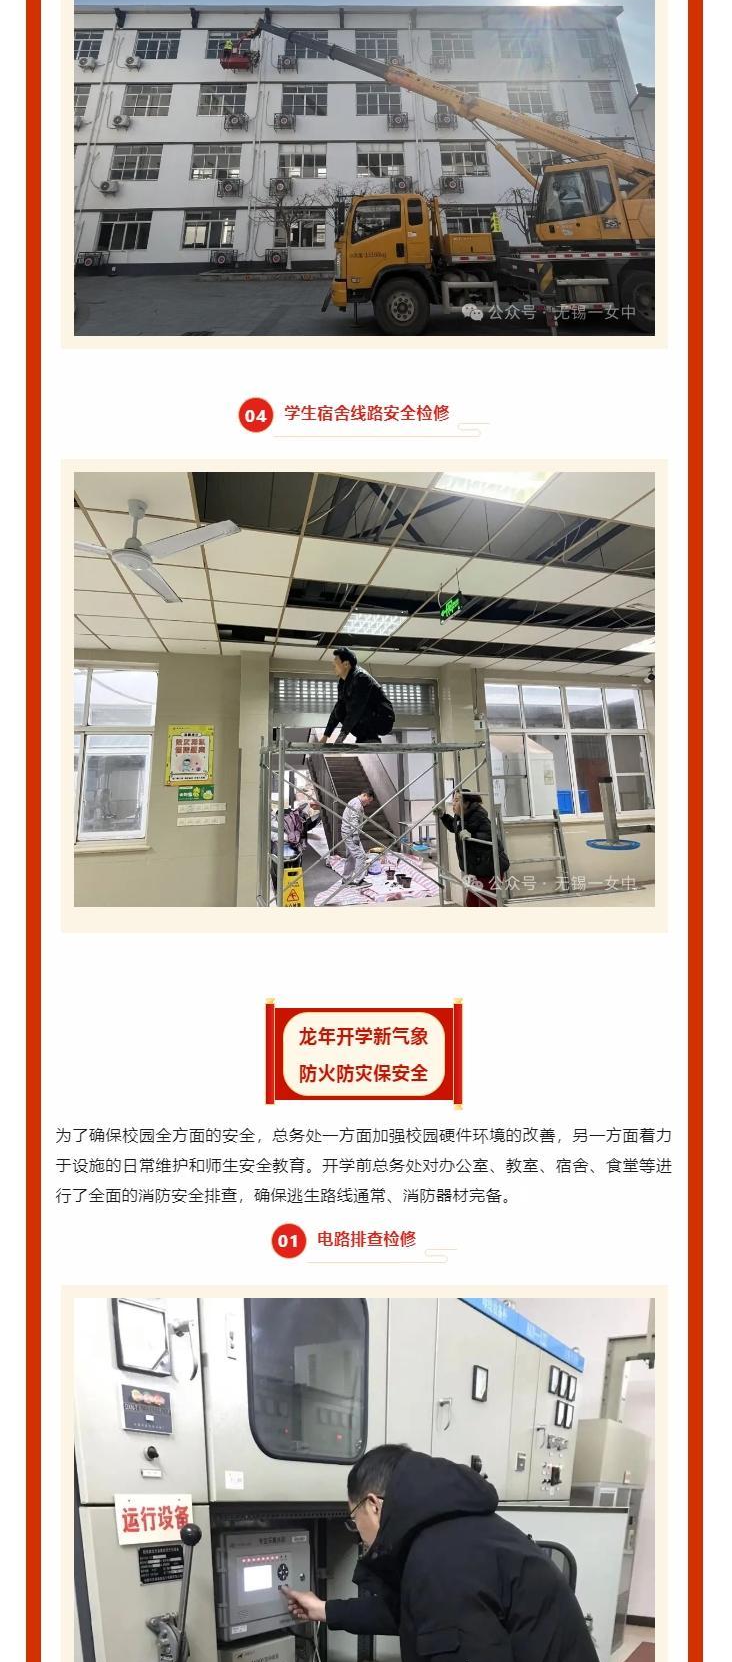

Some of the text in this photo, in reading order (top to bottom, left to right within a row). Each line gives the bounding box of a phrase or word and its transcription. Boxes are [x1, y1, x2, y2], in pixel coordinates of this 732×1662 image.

[245, 405, 449, 423] 04 学生宿舍线路安全检修
[299, 1027, 428, 1046] 龙年开学新气象
[300, 1064, 428, 1083] 防火防灾保安全
[56, 1127, 671, 1144] 为了确保校园全方面的安全，总务处一方面加强校园硬件环境的改善，另一方面着力
[56, 1157, 672, 1173] 于设施的日常维护和师生安全教育。开学前总务处对办公室、教室、宿舍、食堂等进
[56, 1187, 508, 1203] 行了全面的消防安全排查，确保逃生路线通常、消防器材完备。
[278, 1231, 416, 1248] 01 电路排查检修
[122, 1505, 190, 1534] 运行设备
